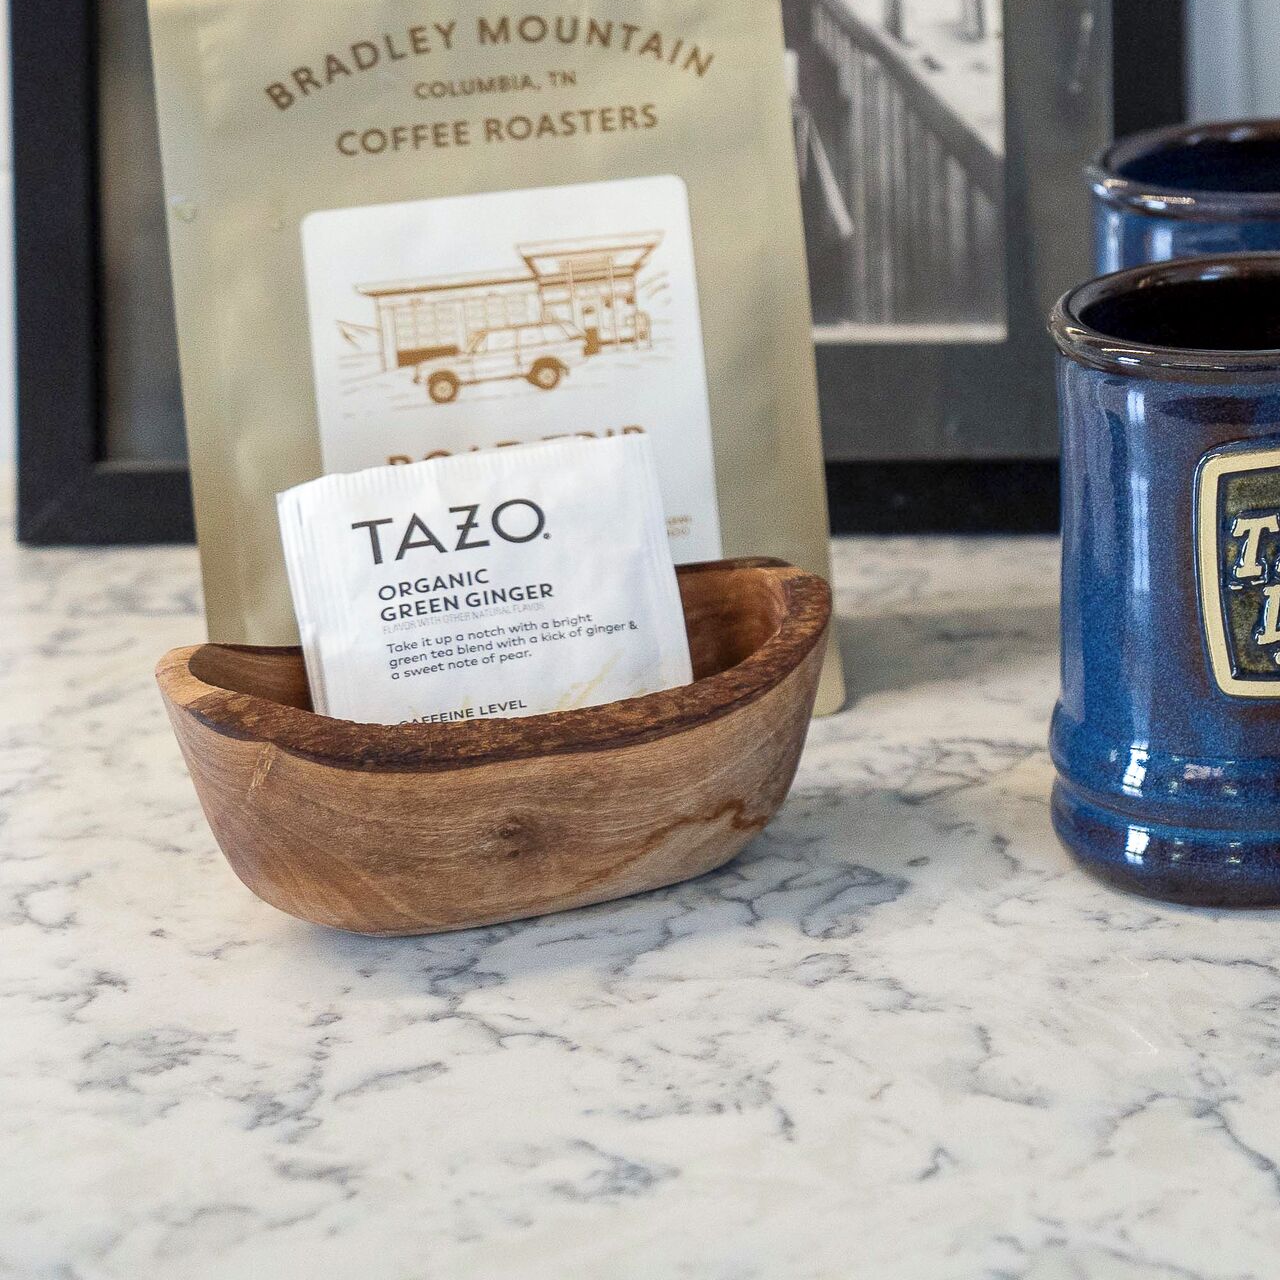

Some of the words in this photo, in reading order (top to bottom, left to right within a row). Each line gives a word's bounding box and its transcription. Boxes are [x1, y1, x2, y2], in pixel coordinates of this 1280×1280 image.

[264, 19, 458, 112] BRADLEY
[476, 14, 716, 79] MOUNTAIN
[413, 73, 542, 100] COLUMBIA,
[547, 70, 578, 89] TN
[335, 119, 471, 157] COFFEE
[483, 102, 659, 143] ROASTERS
[378, 568, 490, 601] ORGANIC
[380, 594, 460, 622] GREEN
[465, 582, 555, 608] GINGER
[386, 640, 418, 654] Take
[421, 637, 433, 647] it
[435, 634, 453, 646] up
[455, 633, 465, 642] a
[468, 625, 505, 641] notch
[508, 621, 538, 634] with
[541, 621, 550, 630] a
[552, 613, 593, 629] bright
[389, 652, 428, 669] green
[431, 648, 454, 660] tea
[457, 640, 494, 655] blend
[496, 635, 526, 650] with
[529, 635, 538, 644] a
[541, 630, 567, 643] kick
[569, 626, 583, 638] of
[586, 622, 626, 637] ginger
[628, 619, 638, 630] &
[391, 671, 400, 681] a
[403, 662, 445, 679] sweet
[447, 657, 478, 671] note
[481, 654, 496, 665] of
[499, 648, 533, 665] pear.
[479, 699, 528, 716] LEVEL
